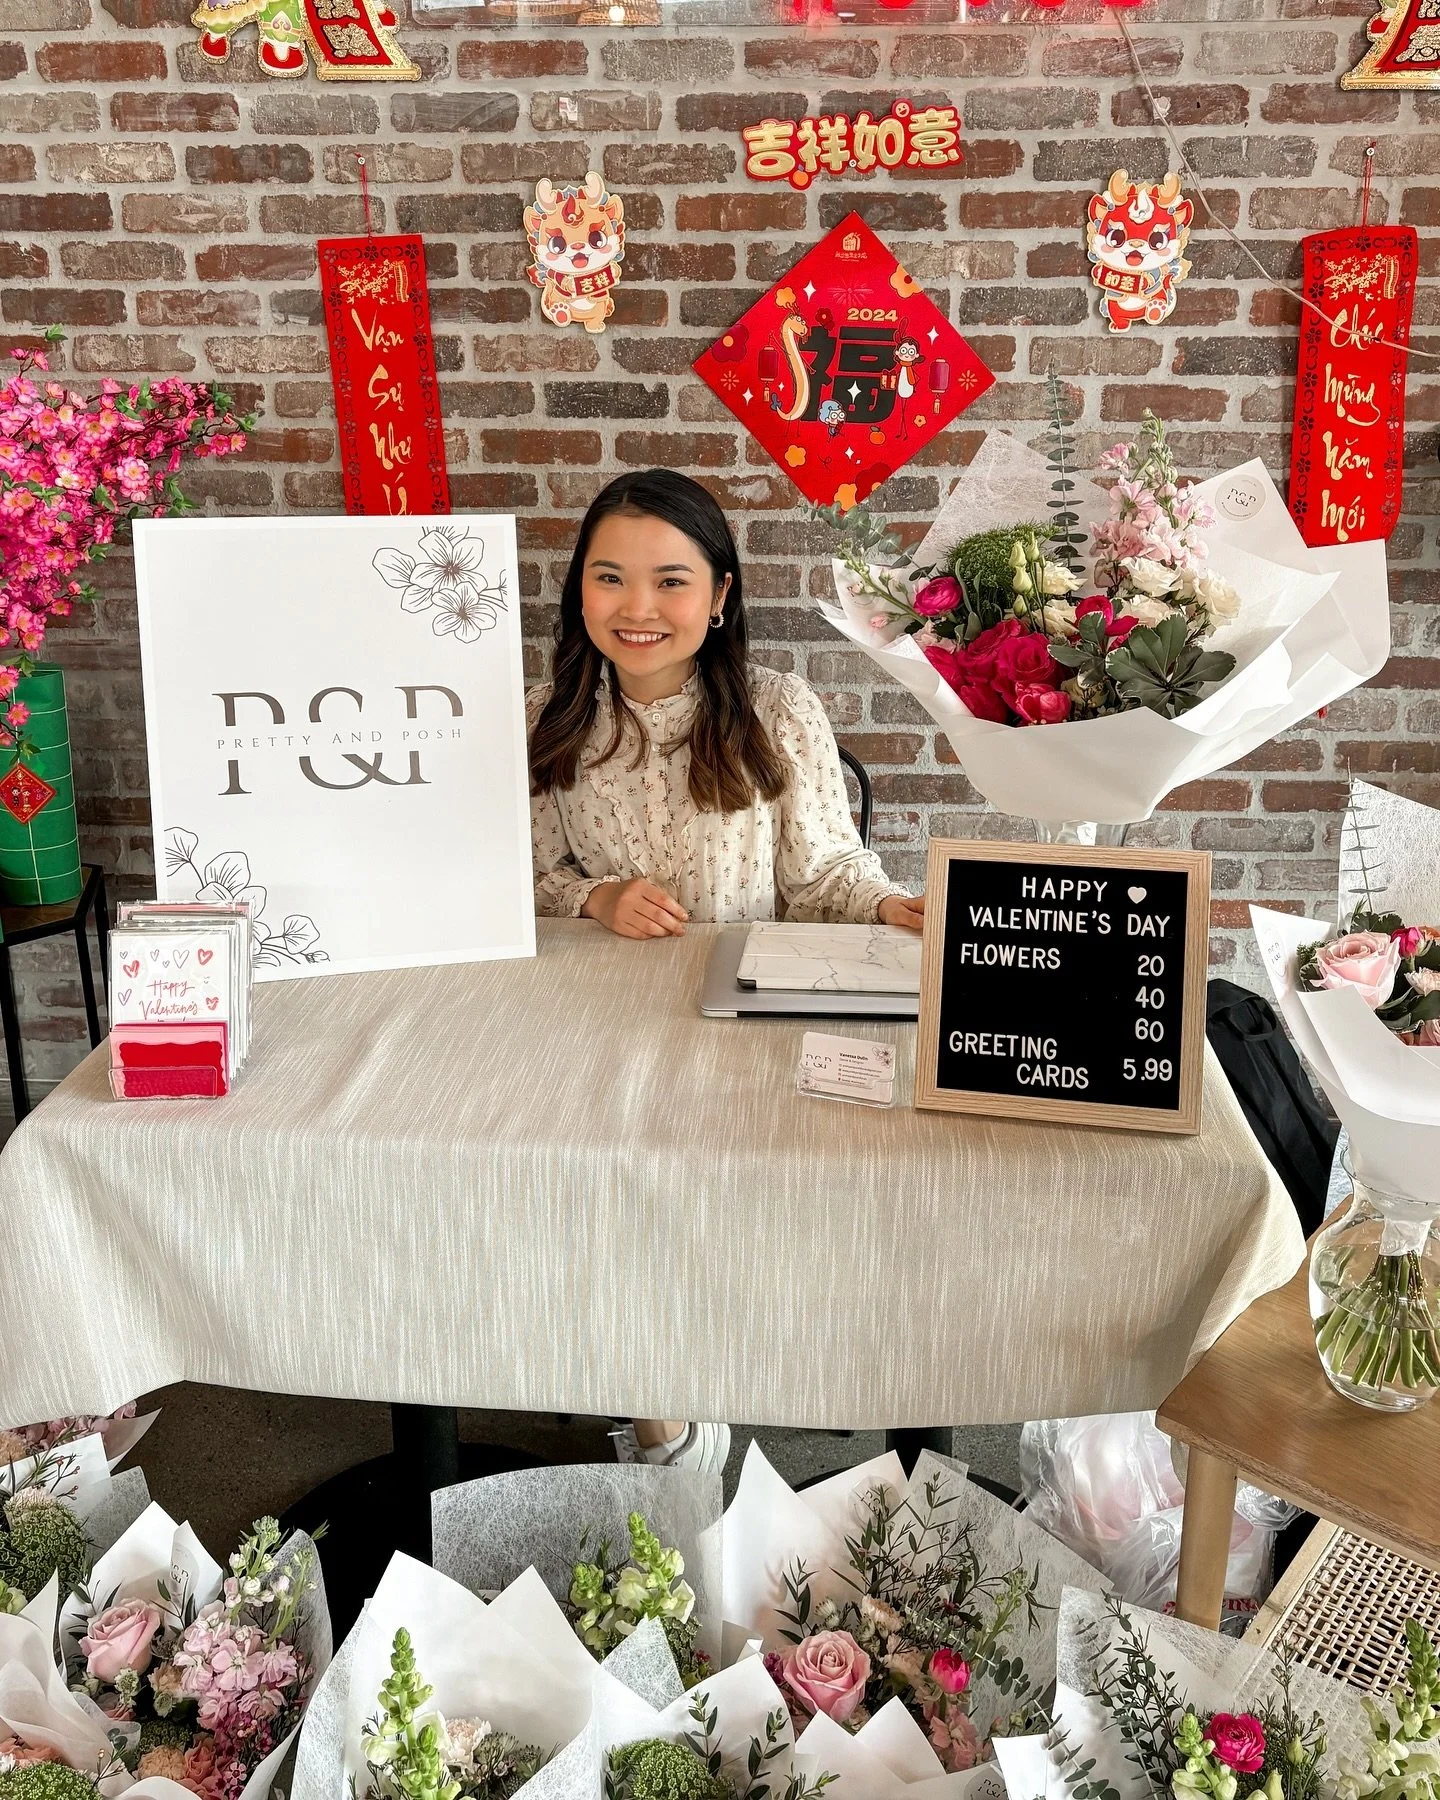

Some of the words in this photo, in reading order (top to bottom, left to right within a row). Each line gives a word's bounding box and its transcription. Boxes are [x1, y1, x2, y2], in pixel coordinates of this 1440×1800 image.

[744, 109, 959, 177] 吉祥如意
[580, 271, 610, 293] 吉祥
[1104, 271, 1135, 292] 如意
[847, 308, 898, 322] 2024
[351, 308, 404, 353] Vạn
[368, 364, 404, 411] Sự
[798, 326, 899, 424] 福
[217, 735, 312, 749] PRETTY
[332, 731, 382, 744] AND
[402, 728, 461, 741] POSH
[1022, 877, 1108, 902] HAPPY
[969, 906, 1112, 935] VALENTINE'S
[1127, 914, 1170, 938] DAY
[961, 943, 1061, 970] FLOWERS
[1137, 955, 1165, 977] 20
[146, 979, 195, 998] Happy
[1135, 986, 1165, 1009] 40
[1135, 1018, 1165, 1042] 60
[949, 1031, 1058, 1060] GREETING
[1016, 1063, 1089, 1089] CARDS
[1123, 1058, 1173, 1081] 5.99
